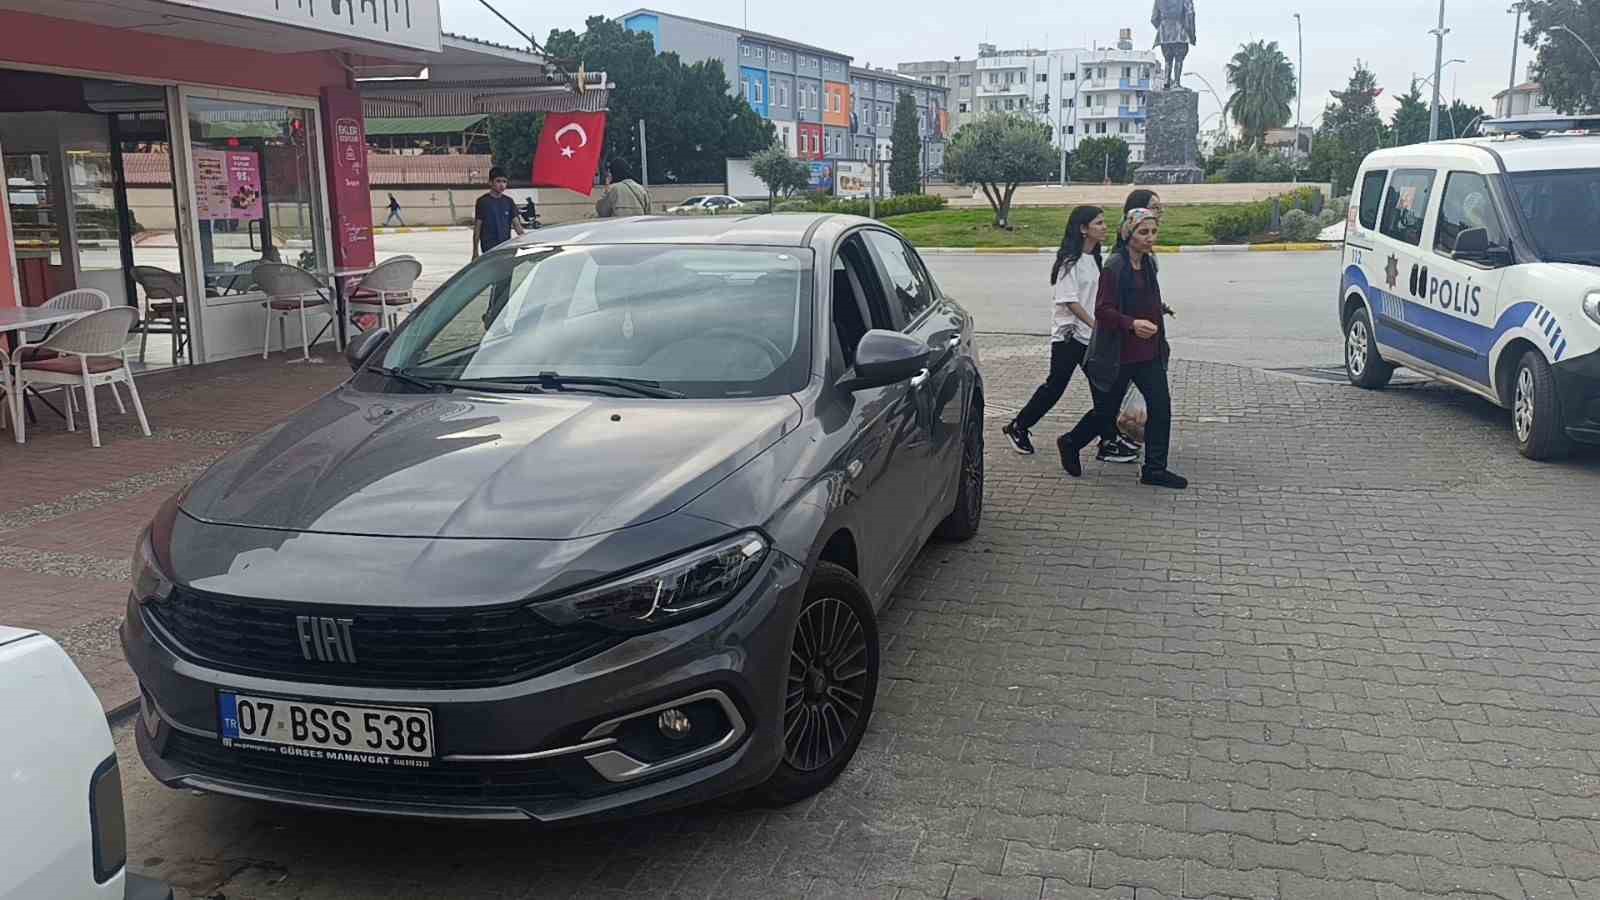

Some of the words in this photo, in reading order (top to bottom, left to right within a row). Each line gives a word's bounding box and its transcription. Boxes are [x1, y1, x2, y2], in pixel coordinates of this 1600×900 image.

[1429, 275, 1481, 317] POLİS
[296, 615, 357, 663] FIAT
[224, 718, 237, 729] TR
[238, 700, 274, 737] 07
[290, 705, 352, 746] BSS
[363, 712, 427, 753] 538
[326, 751, 390, 765] MANAVGAT
